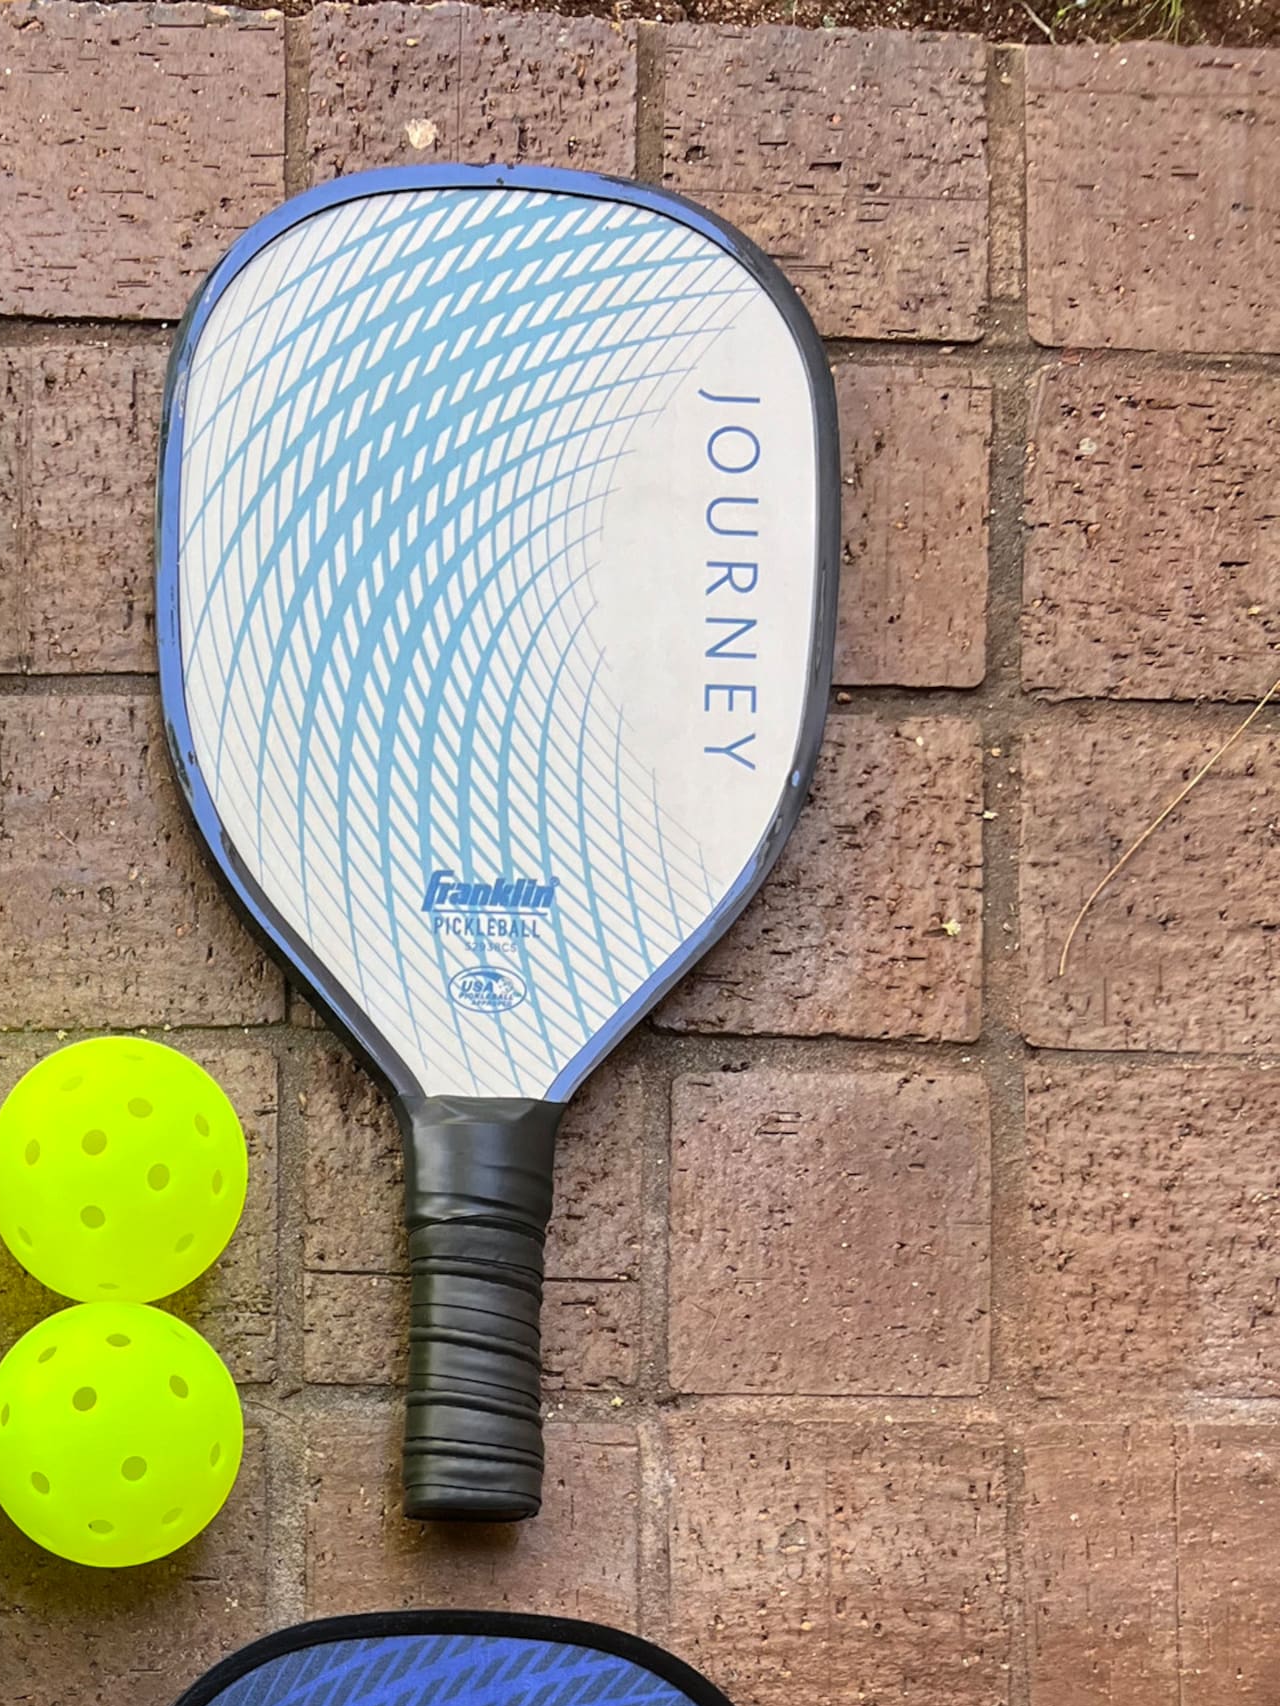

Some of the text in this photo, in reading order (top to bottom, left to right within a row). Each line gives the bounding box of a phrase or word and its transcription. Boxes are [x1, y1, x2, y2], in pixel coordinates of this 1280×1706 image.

[698, 388, 761, 770] JOURNEY
[434, 916, 541, 939] PICKLEBALL
[461, 980, 494, 993] USA
